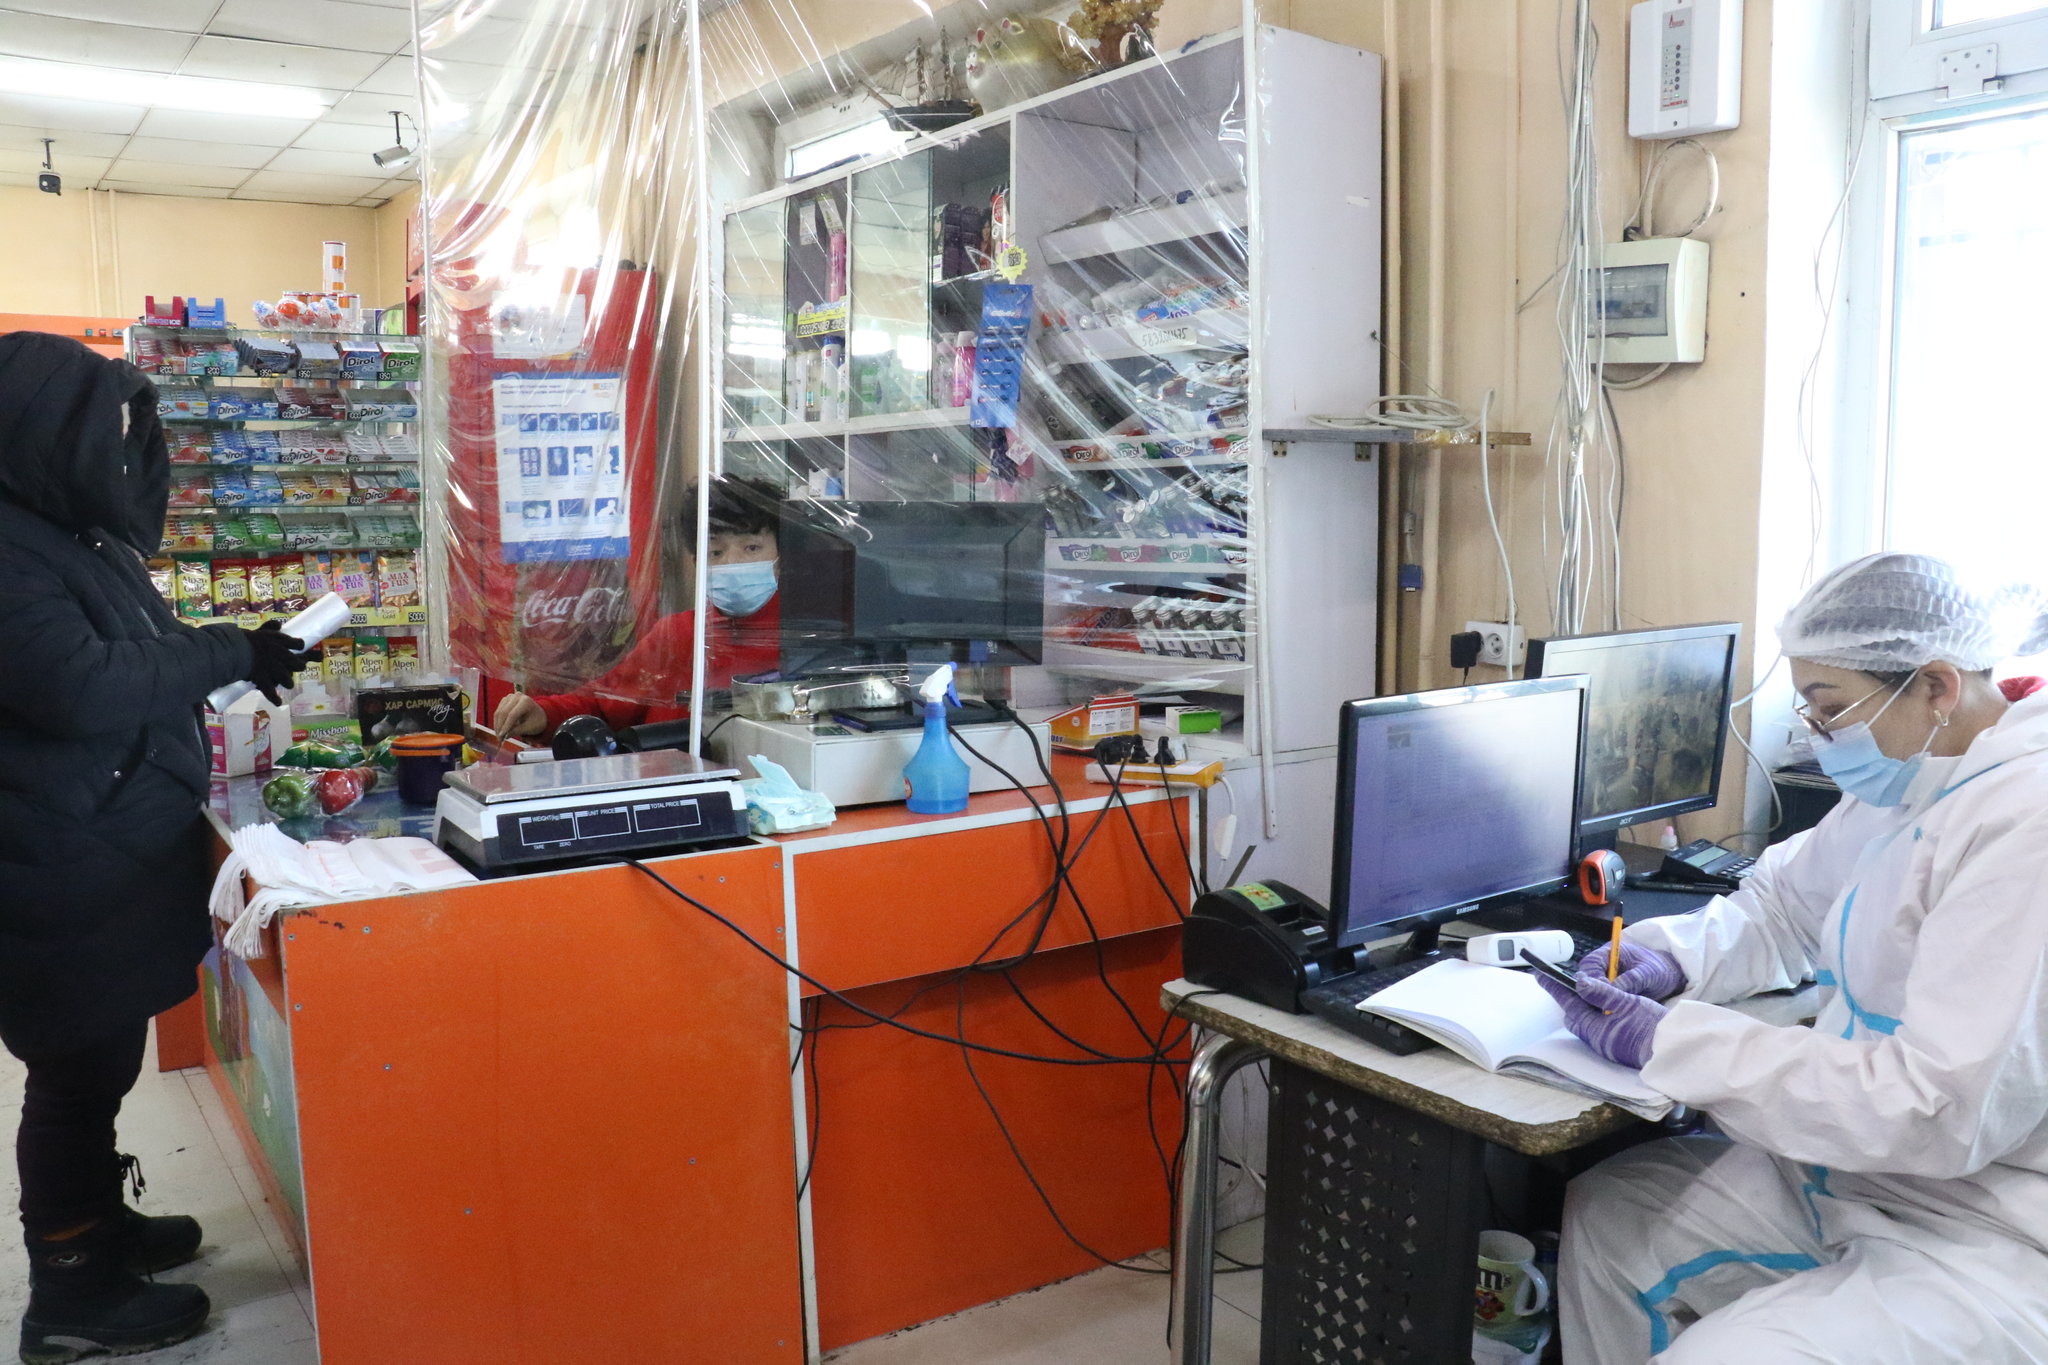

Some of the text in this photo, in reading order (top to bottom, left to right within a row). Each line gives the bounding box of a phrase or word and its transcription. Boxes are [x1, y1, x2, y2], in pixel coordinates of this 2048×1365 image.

[347, 356, 375, 367] Dirol
[388, 357, 415, 368] Dirol
[217, 405, 241, 415] Dirol
[360, 407, 384, 416] Dirol
[1076, 450, 1092, 460] Dirol
[365, 490, 387, 500] Dirol
[160, 538, 175, 547] rol
[1074, 547, 1091, 559] Dirol
[1123, 548, 1140, 559] Dirol
[1172, 548, 1192, 559] Dirol
[342, 573, 364, 583] MAX
[388, 572, 409, 580] MAX
[220, 581, 245, 591] Alpen
[280, 585, 301, 593] Gold
[222, 588, 243, 597] Gold
[360, 657, 383, 667] Alpen
[392, 659, 415, 669] Alpen
[330, 667, 351, 675] Gold
[385, 700, 404, 710] ХАР
[600, 807, 616, 815] PRICE
[1456, 903, 1480, 915] SAMSUNG
